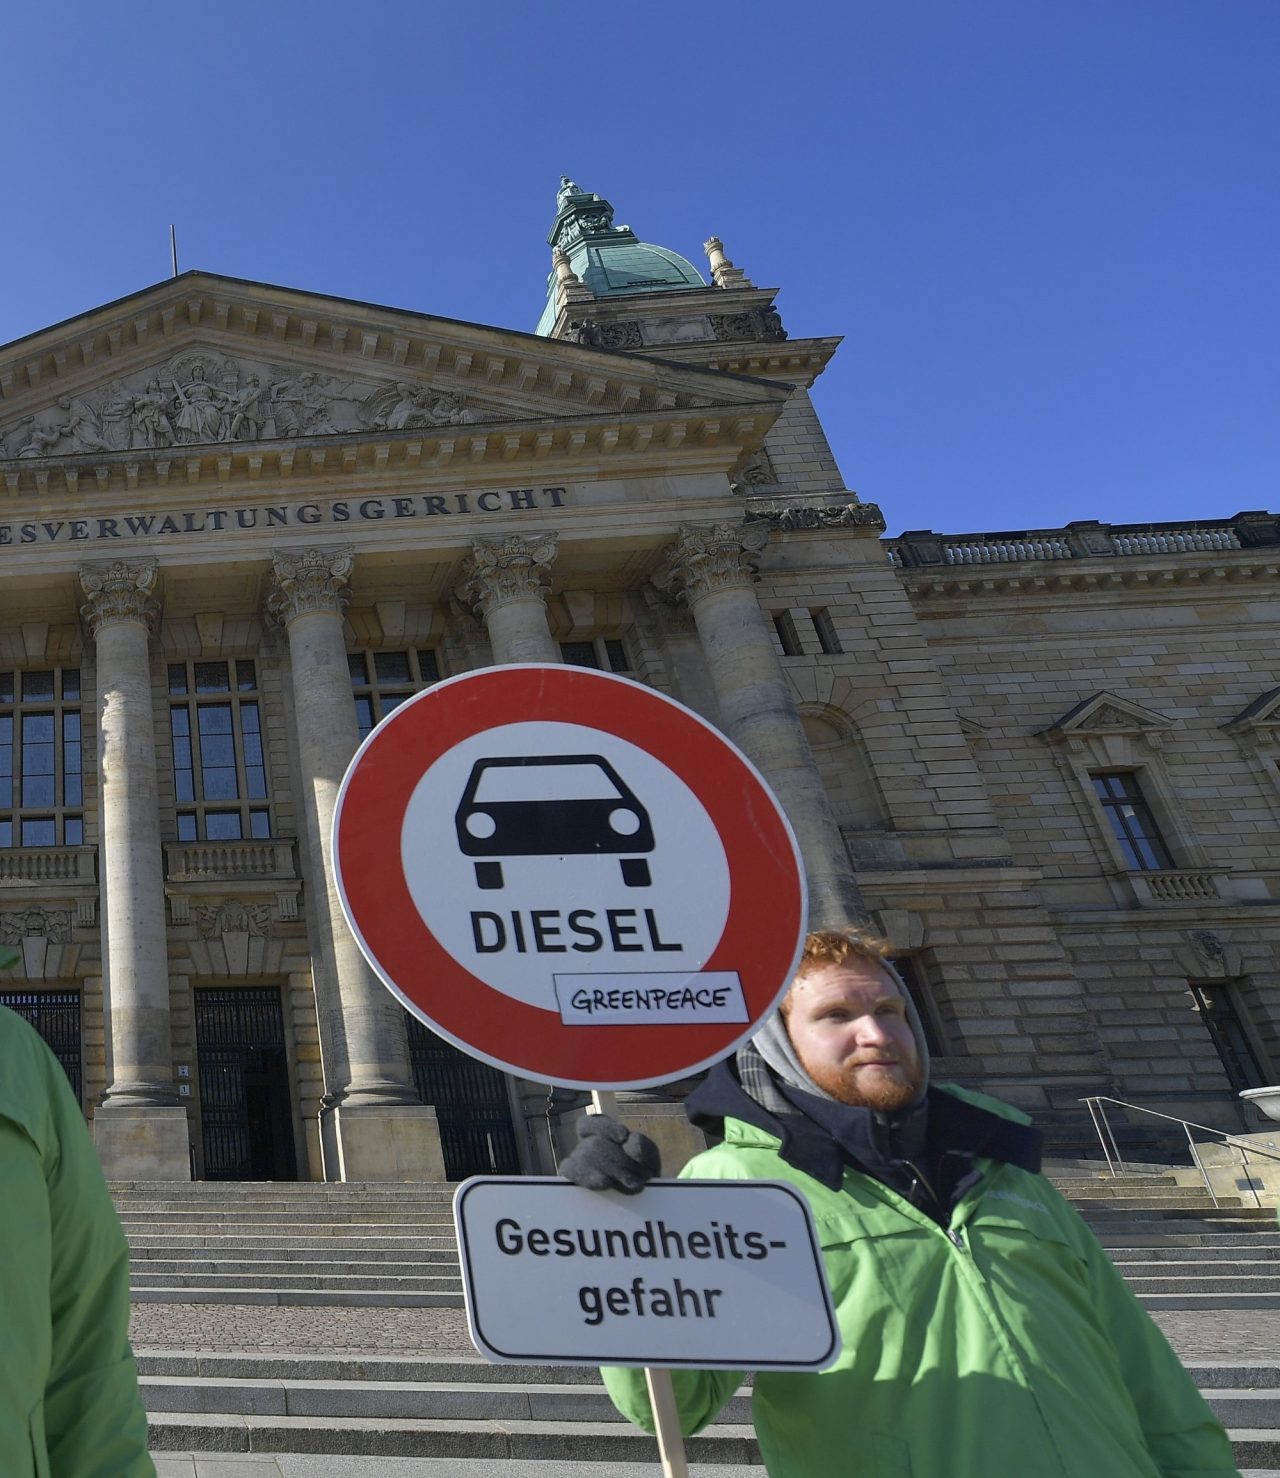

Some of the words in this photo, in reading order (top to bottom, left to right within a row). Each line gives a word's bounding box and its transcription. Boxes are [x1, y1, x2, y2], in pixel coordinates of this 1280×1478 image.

[470, 908, 683, 953] DIESEL
[570, 987, 732, 1013] GREENPEACE
[494, 1218, 786, 1260] Gesundheits-
[578, 1277, 723, 1325] gefahr
